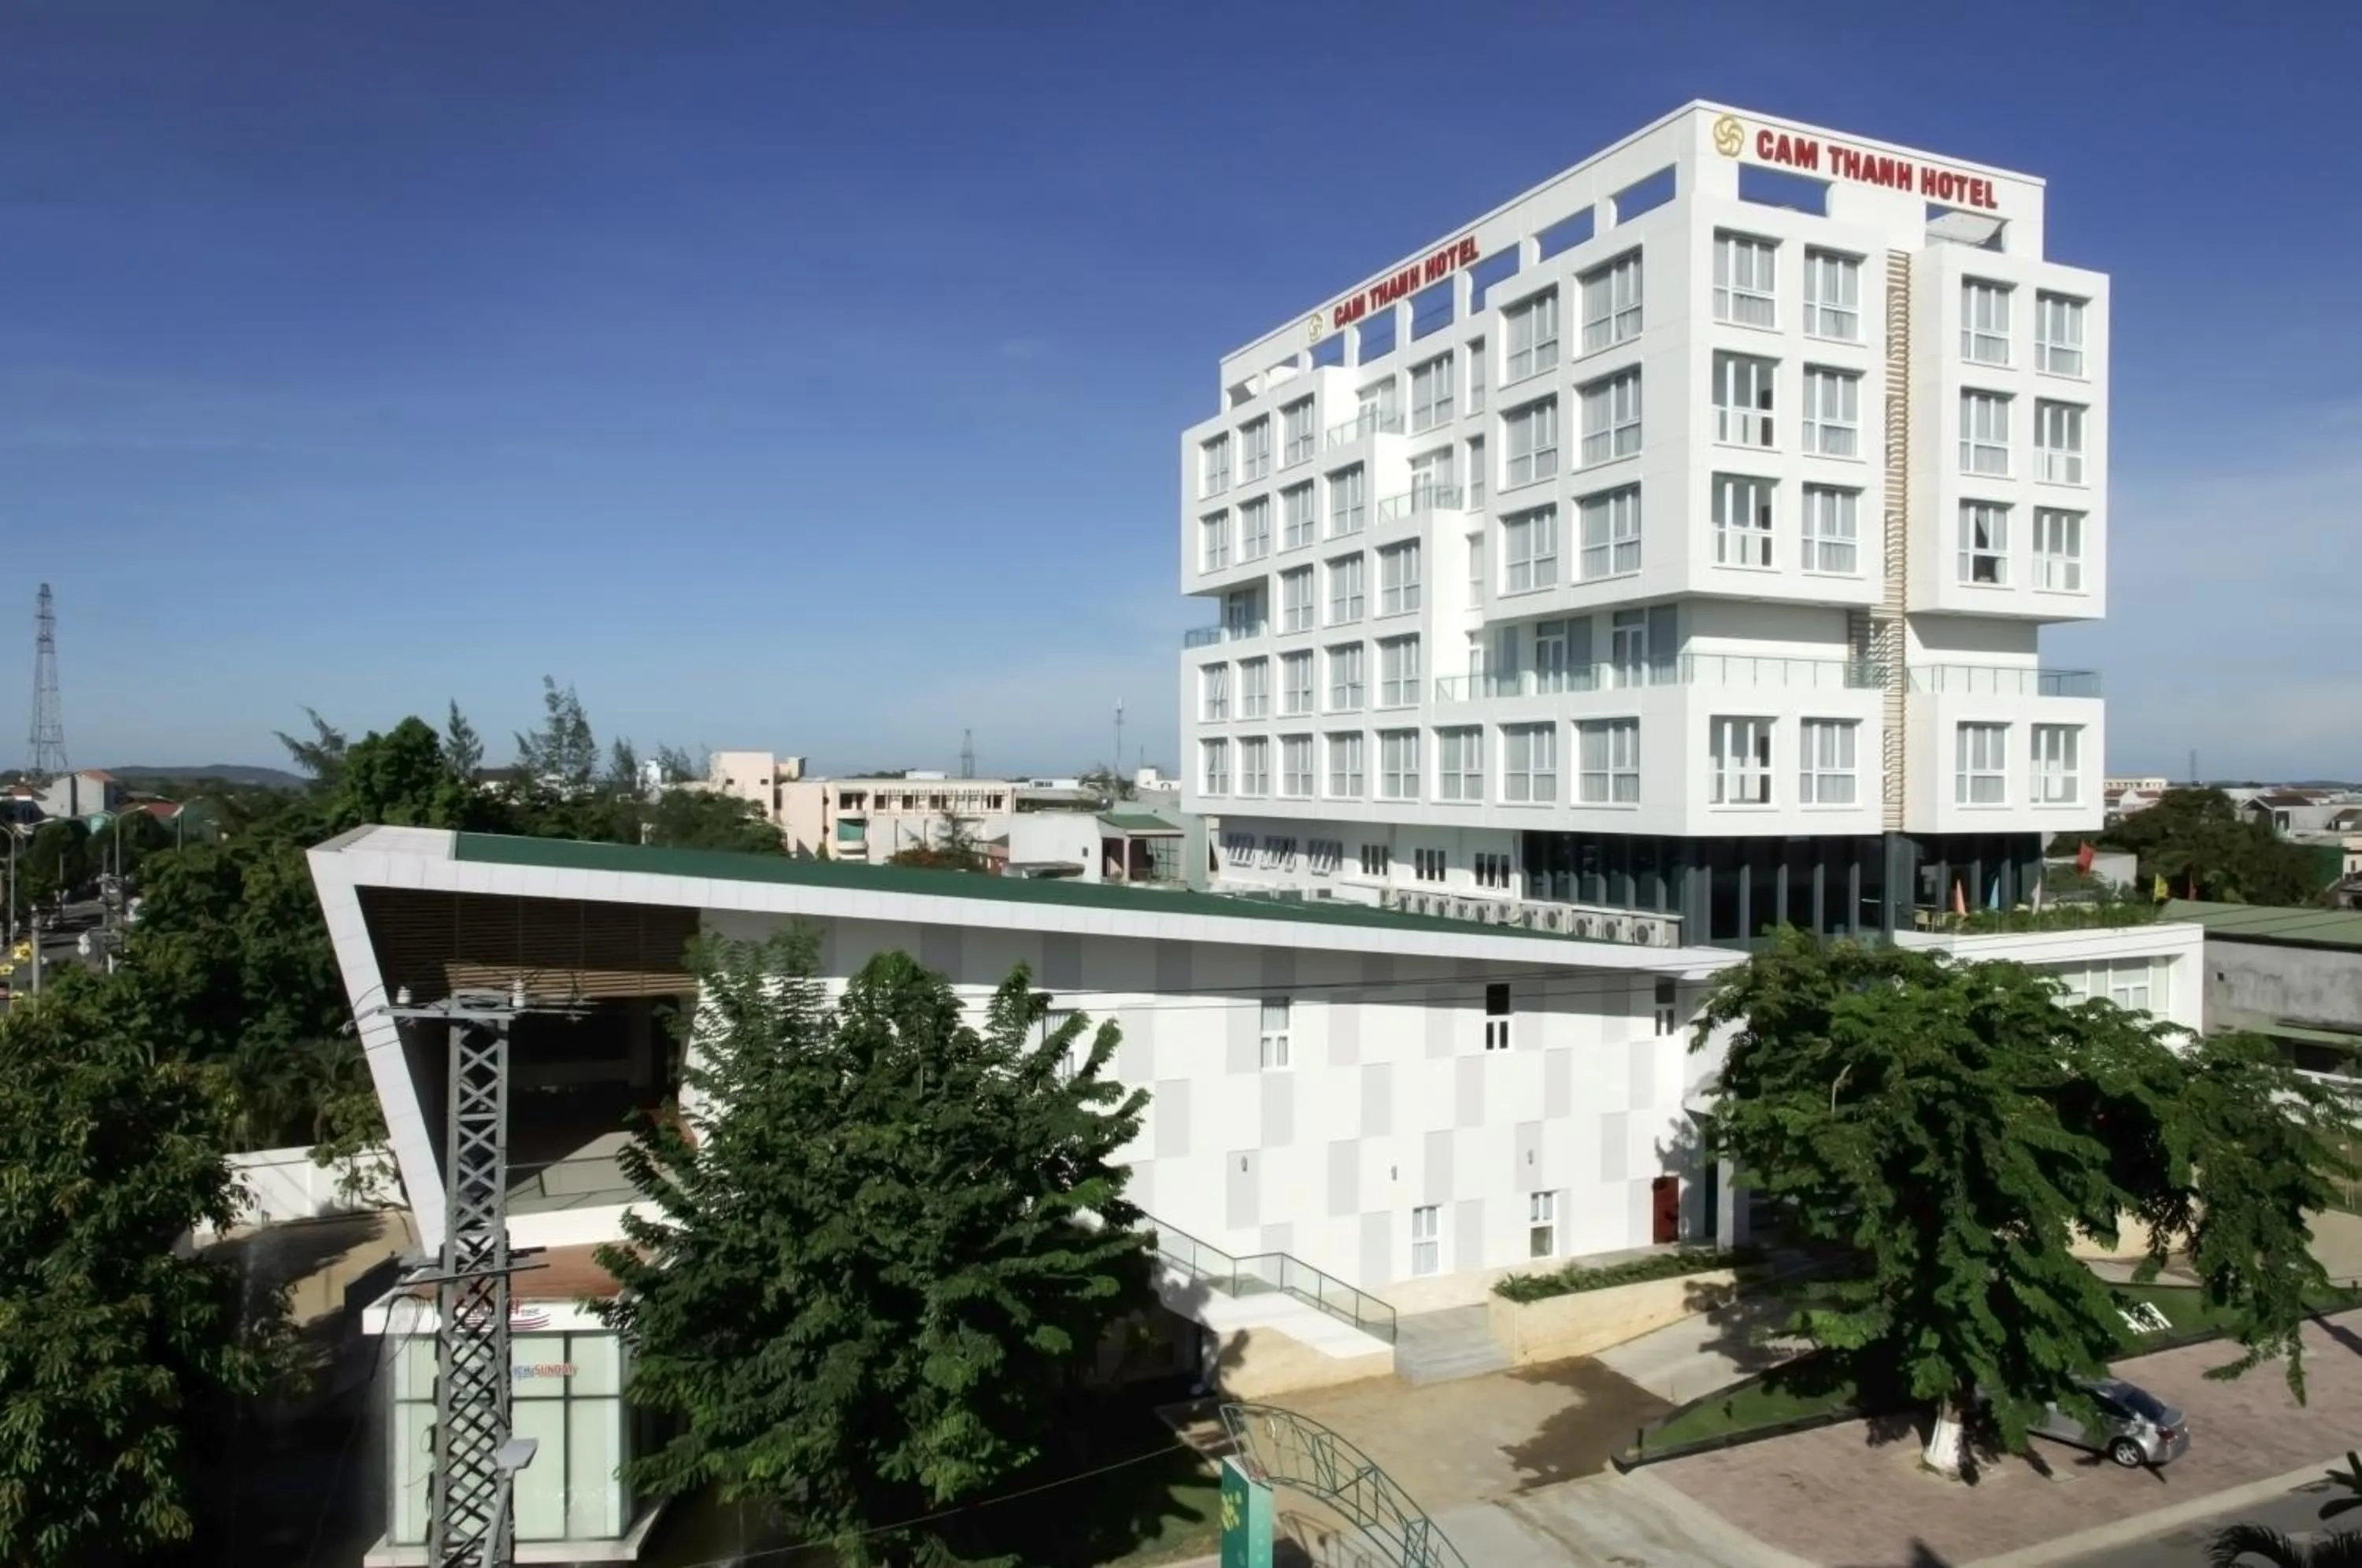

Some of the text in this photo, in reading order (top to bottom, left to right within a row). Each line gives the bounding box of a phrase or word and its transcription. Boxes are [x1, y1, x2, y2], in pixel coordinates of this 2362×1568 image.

[1757, 130, 1997, 209] CAM THANH HOTEL
[1334, 236, 1479, 328] CAM THANH HOTEL
